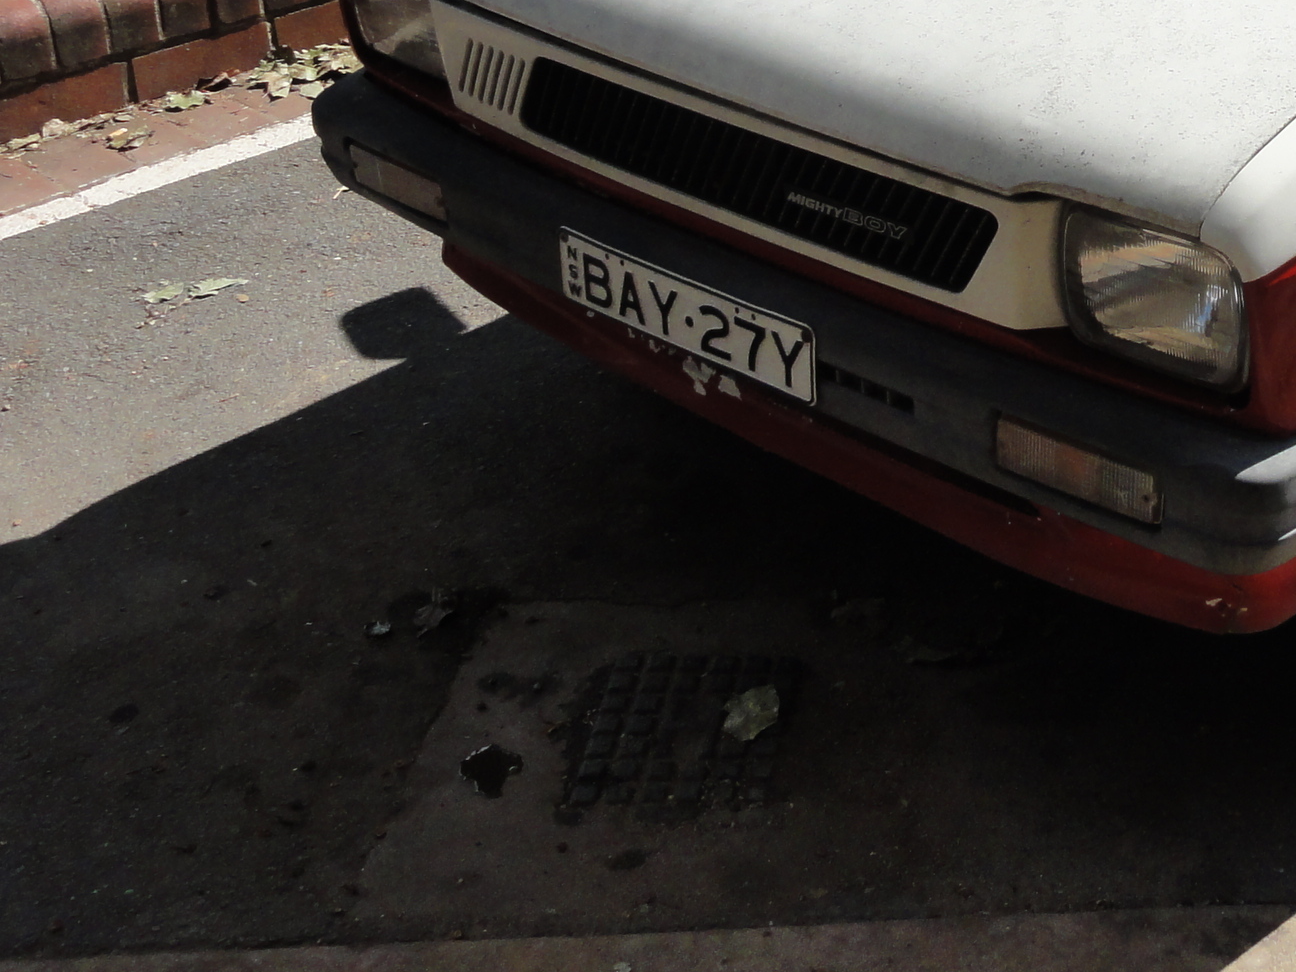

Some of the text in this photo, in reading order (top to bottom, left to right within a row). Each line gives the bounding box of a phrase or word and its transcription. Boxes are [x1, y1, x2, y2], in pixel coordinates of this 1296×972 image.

[787, 191, 908, 240] MIGHTY BOY
[566, 245, 583, 298] NSW
